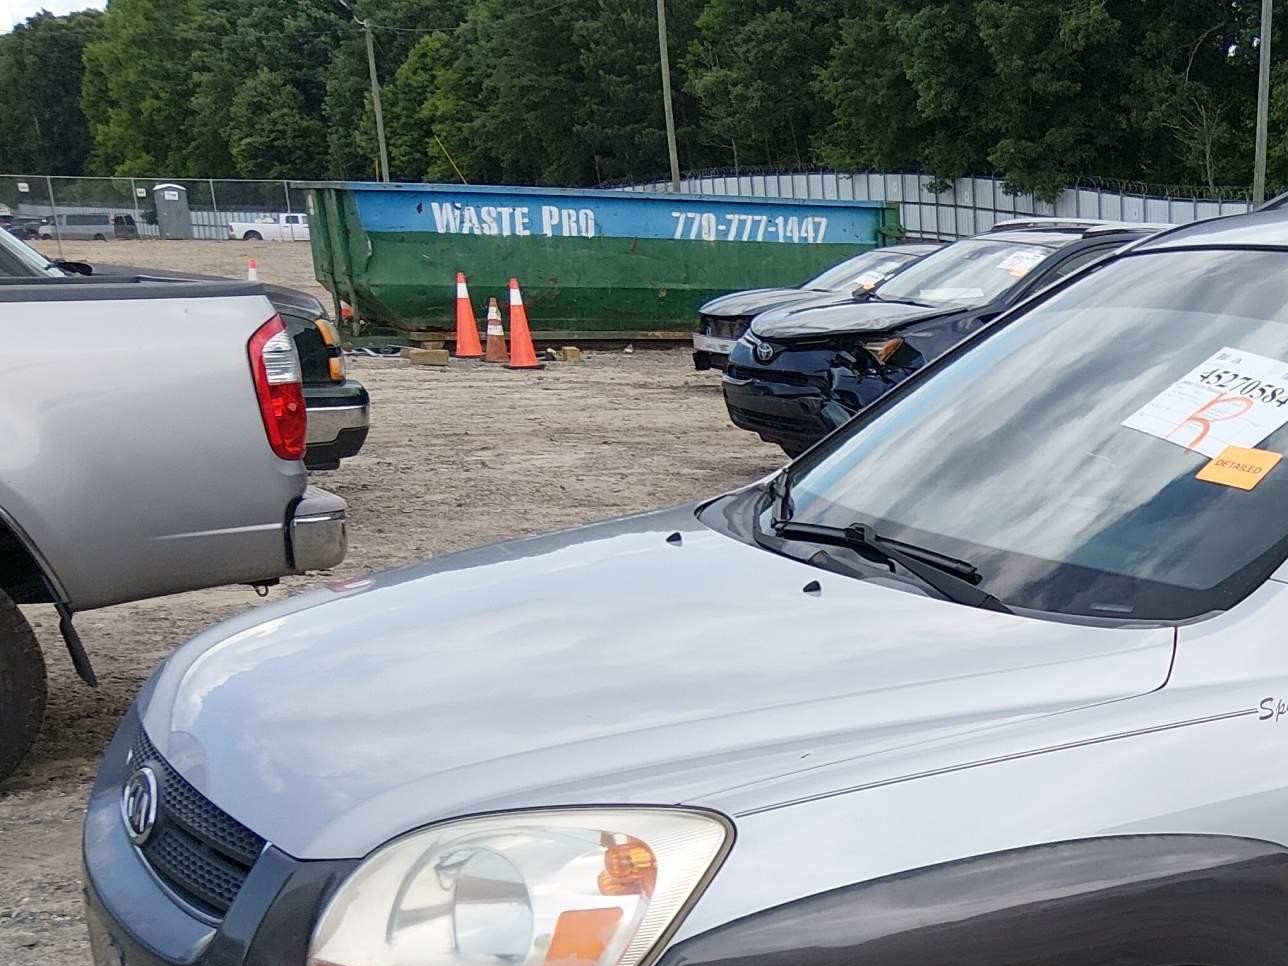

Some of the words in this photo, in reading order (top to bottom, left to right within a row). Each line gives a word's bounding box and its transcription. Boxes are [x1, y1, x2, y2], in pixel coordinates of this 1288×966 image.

[431, 202, 531, 237] WASTE
[541, 205, 596, 239] PRO
[671, 211, 828, 244] 770-777-1447
[1214, 459, 1263, 475] DETAILED
